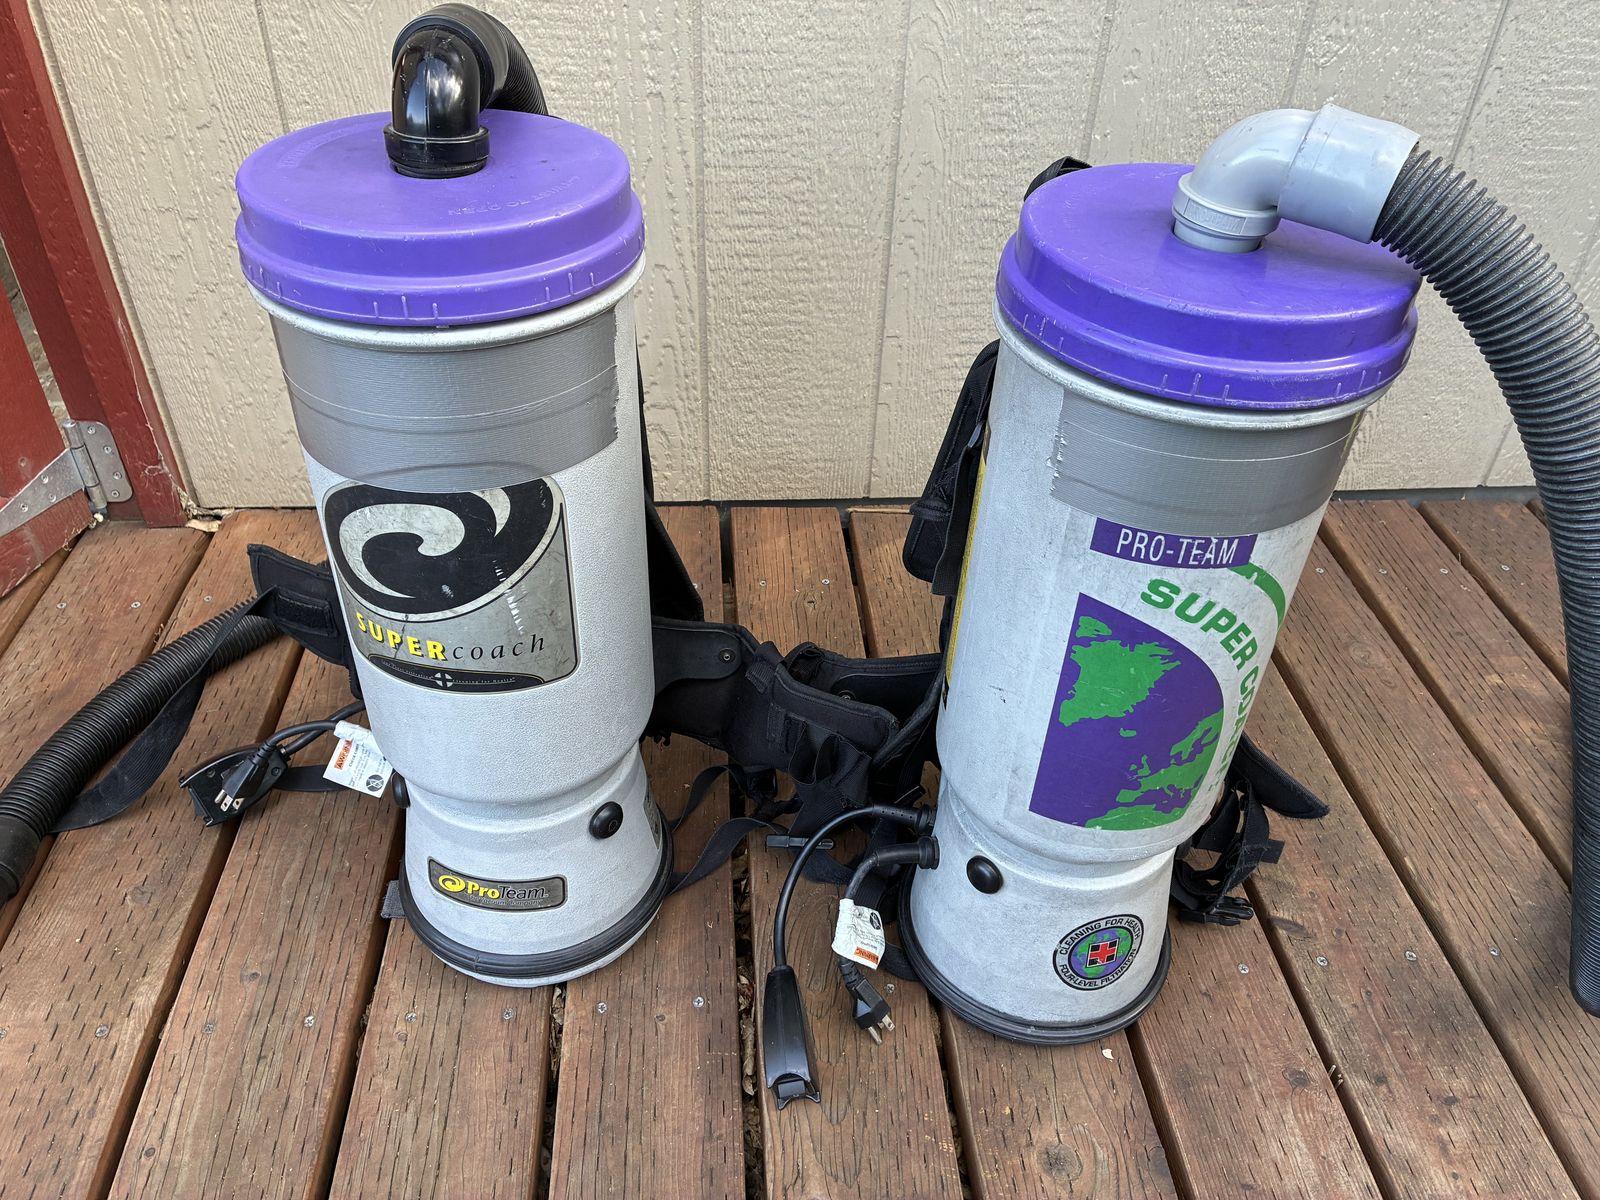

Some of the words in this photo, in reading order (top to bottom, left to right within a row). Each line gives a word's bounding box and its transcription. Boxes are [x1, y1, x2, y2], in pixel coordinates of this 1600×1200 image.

[1115, 528, 1240, 565] PRO-TEAM
[1140, 578, 1259, 671] SUPER
[466, 881, 545, 899] ProTeam
[1060, 922, 1101, 955] CLEANING
[1104, 918, 1124, 927] FOR
[1124, 918, 1141, 941] HEALTH
[1060, 963, 1098, 987] FOUR-LEVEL
[1100, 948, 1137, 986] FILTRATION
